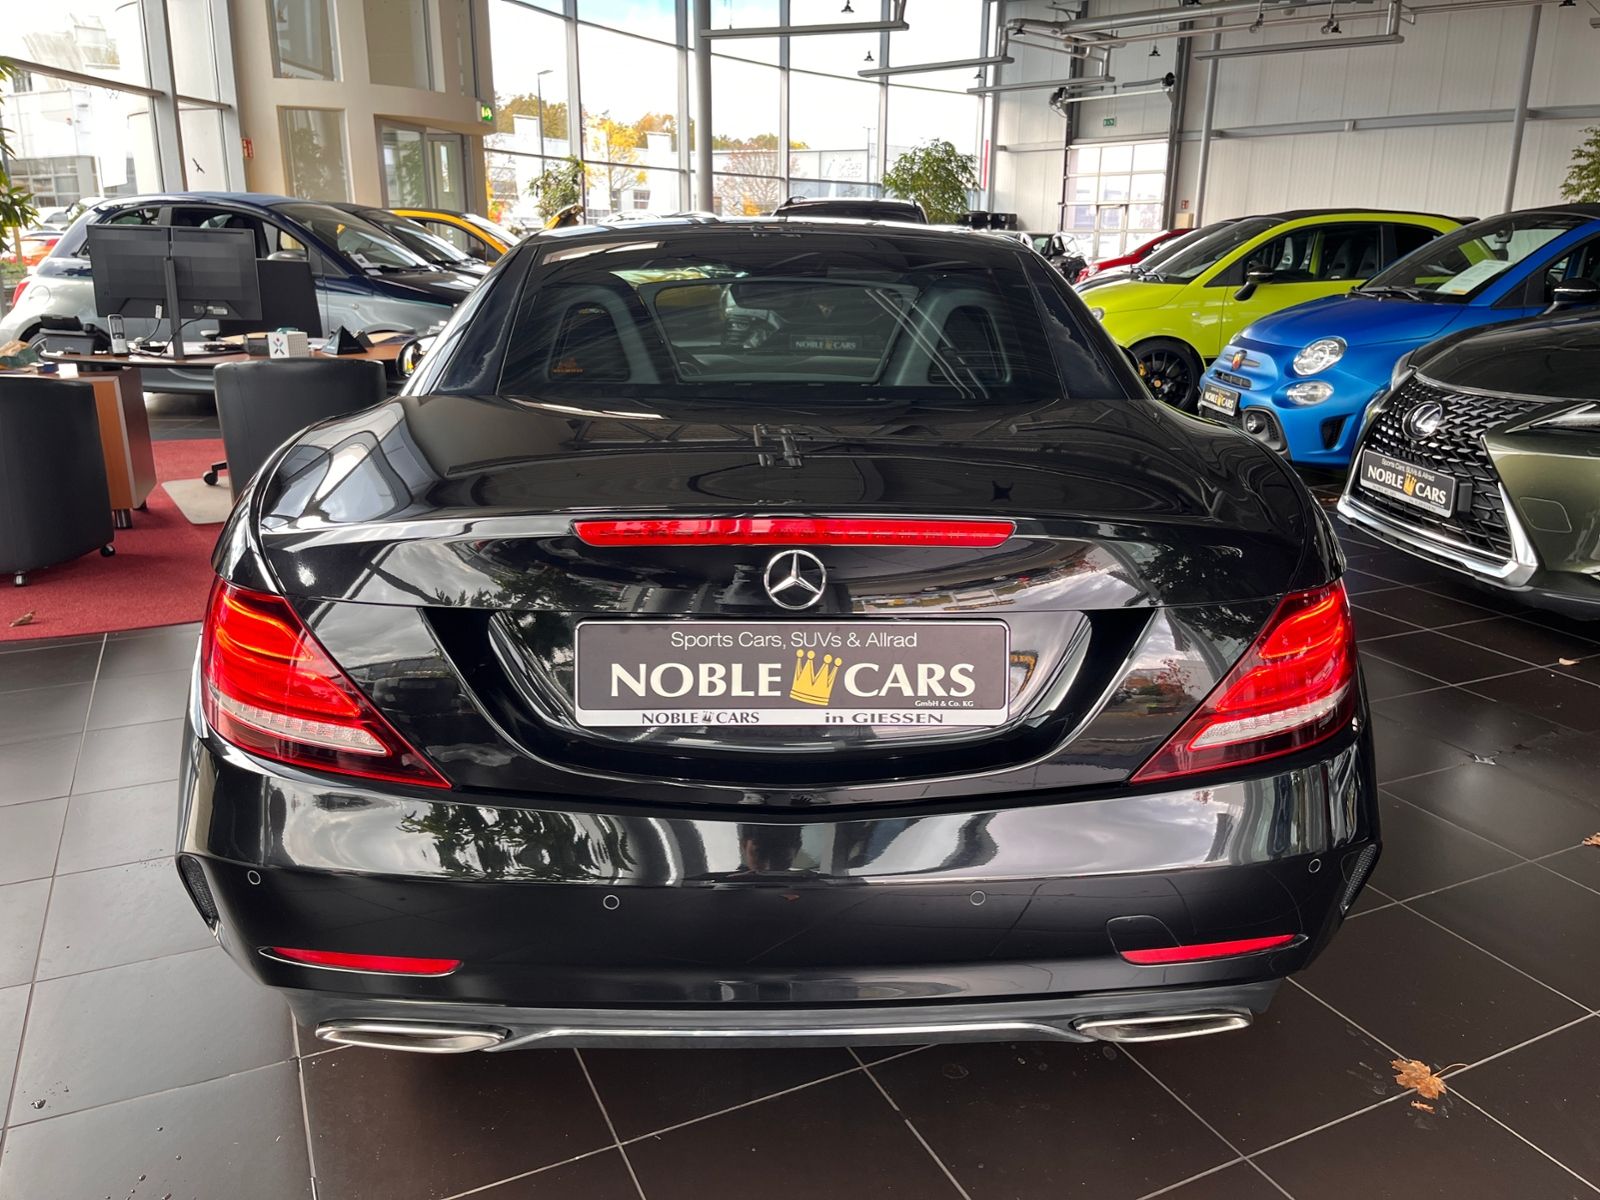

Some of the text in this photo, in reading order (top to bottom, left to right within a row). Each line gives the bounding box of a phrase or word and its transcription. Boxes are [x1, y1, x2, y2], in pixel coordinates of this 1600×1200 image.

[1367, 465, 1404, 489] NOBLE
[1415, 482, 1446, 504] CARS
[670, 631, 918, 650] Sports Cars, SUVs & Allrad
[611, 662, 976, 698] NOBLE CARS
[642, 711, 760, 724] NOBLE CARS
[825, 712, 944, 724] in GIESSEN
